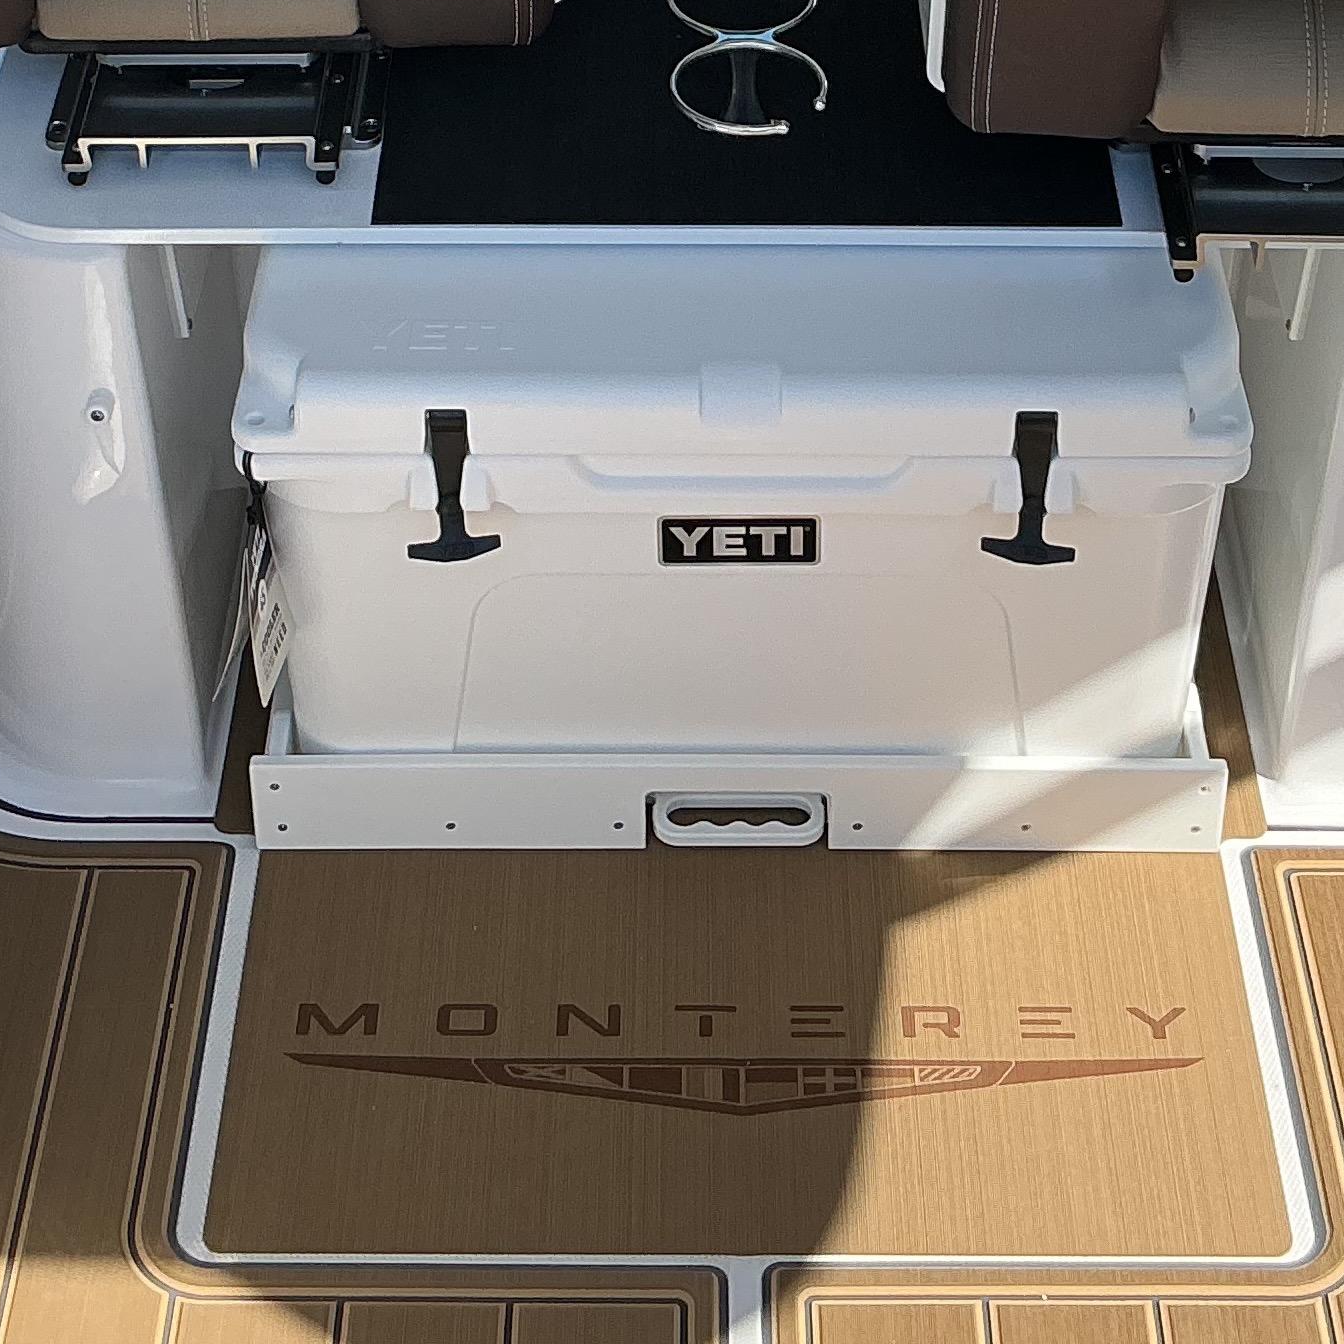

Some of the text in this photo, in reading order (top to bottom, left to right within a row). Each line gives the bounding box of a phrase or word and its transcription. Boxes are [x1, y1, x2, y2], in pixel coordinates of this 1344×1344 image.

[372, 319, 516, 352] YETI
[668, 525, 805, 557] YETI
[295, 1003, 1187, 1041] MONTEREY
